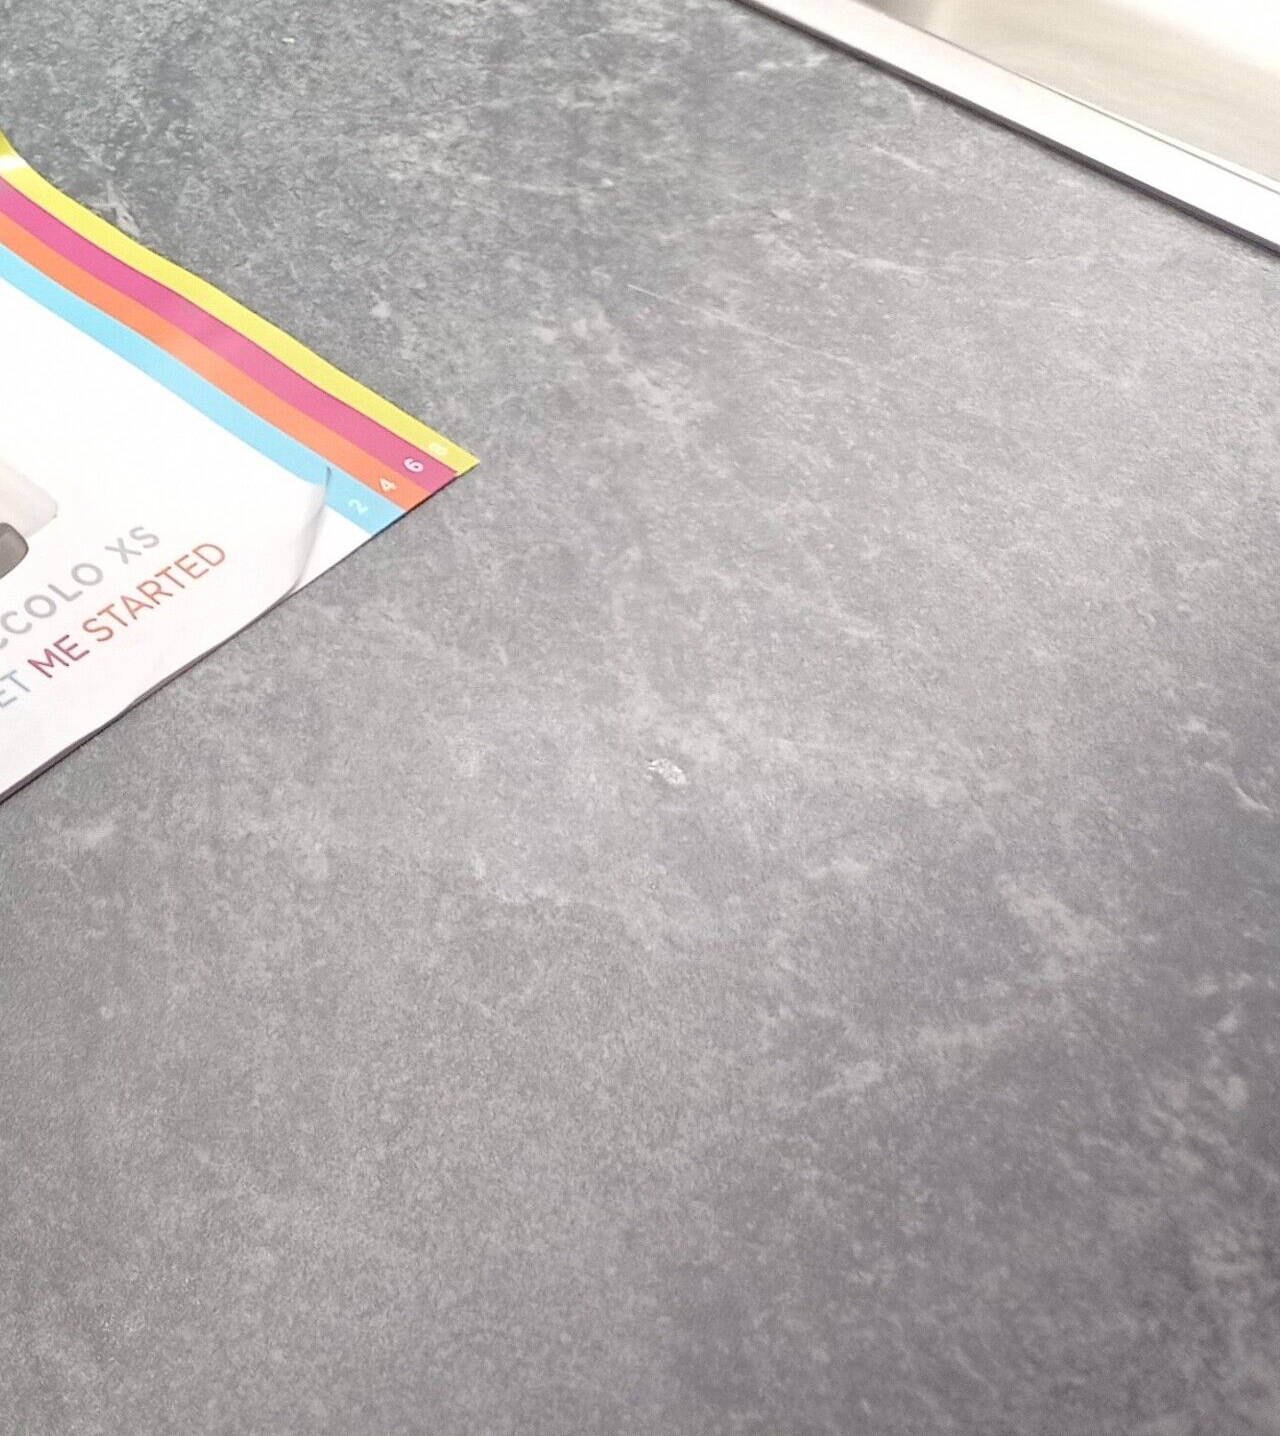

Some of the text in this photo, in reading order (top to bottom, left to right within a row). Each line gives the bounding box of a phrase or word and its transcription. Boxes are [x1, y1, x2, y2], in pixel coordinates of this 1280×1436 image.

[403, 457, 424, 473] 6
[379, 477, 397, 492] 4
[348, 498, 369, 515] 2
[105, 525, 161, 565] XS
[27, 634, 90, 679] ME
[82, 541, 227, 644] STARTED
